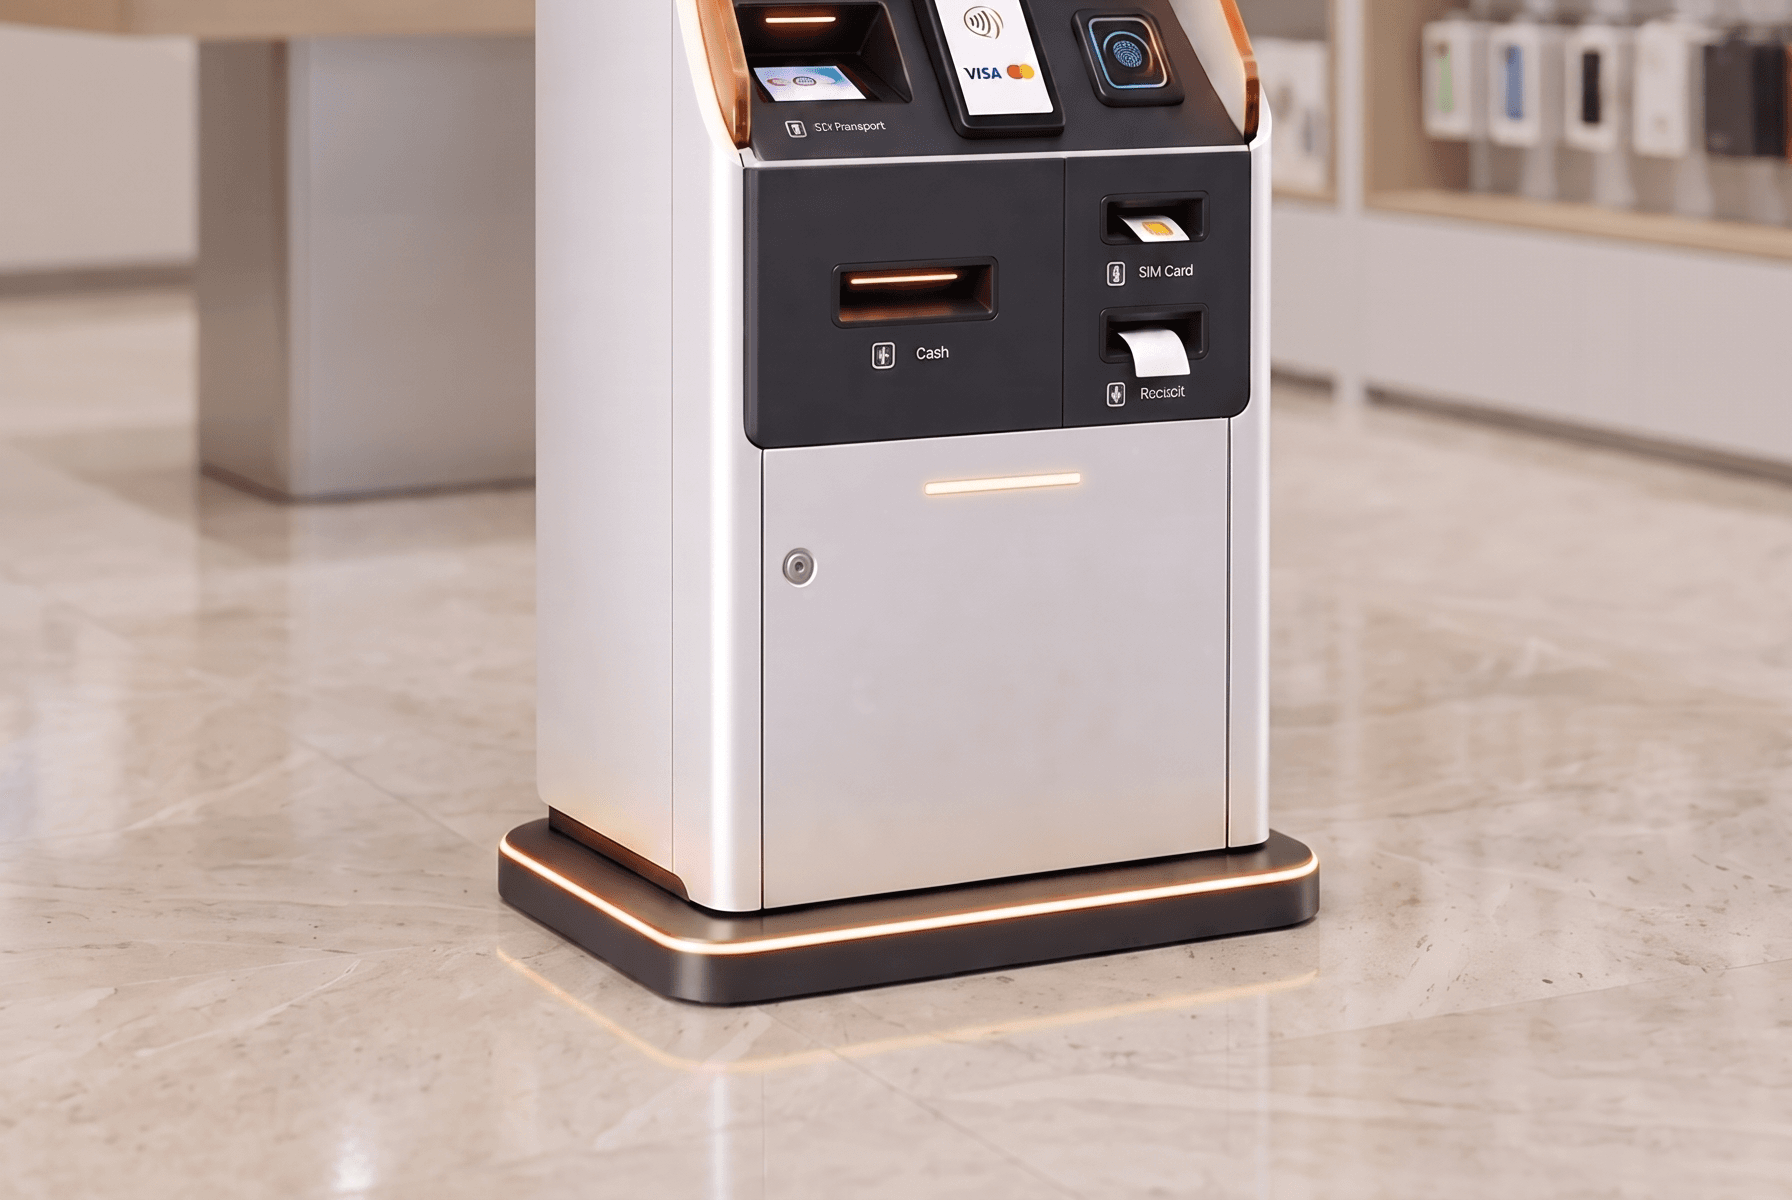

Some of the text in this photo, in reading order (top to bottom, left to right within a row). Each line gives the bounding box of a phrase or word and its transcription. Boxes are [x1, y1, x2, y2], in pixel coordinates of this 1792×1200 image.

[962, 67, 1003, 80] VISA
[1138, 263, 1194, 279] SIM Card
[916, 345, 950, 360] Cash
